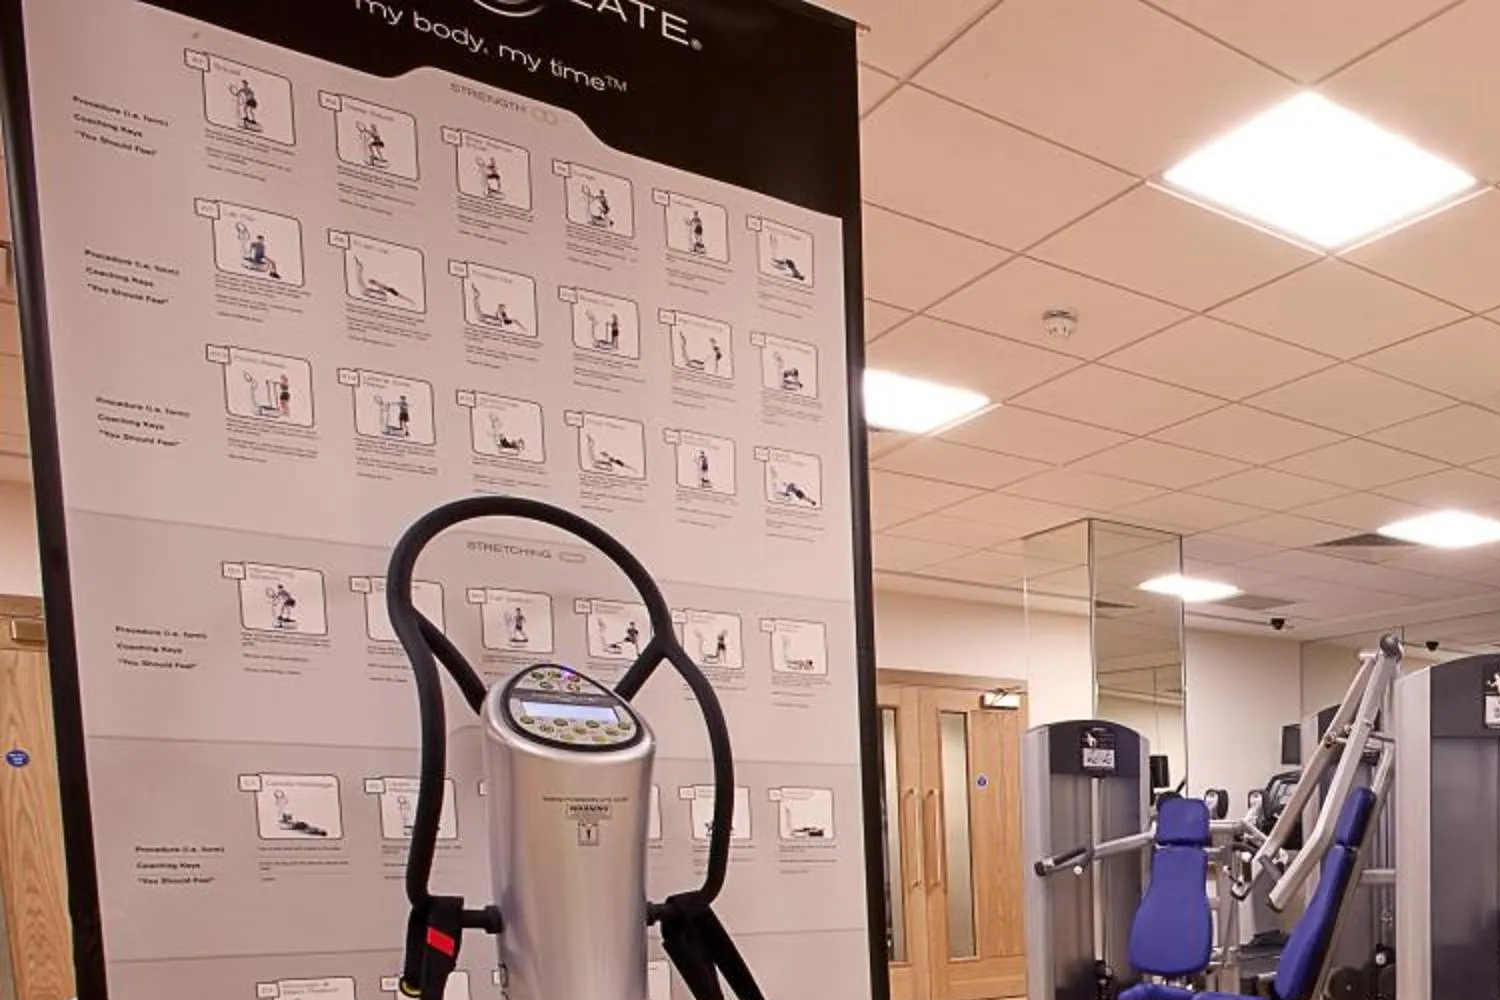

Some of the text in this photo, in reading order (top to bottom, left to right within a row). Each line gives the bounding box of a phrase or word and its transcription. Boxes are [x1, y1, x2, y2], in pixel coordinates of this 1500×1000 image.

[355, 0, 403, 26] my
[498, 44, 541, 73] my
[449, 83, 527, 113] STRENGTH
[466, 540, 552, 559] STRETCHING
